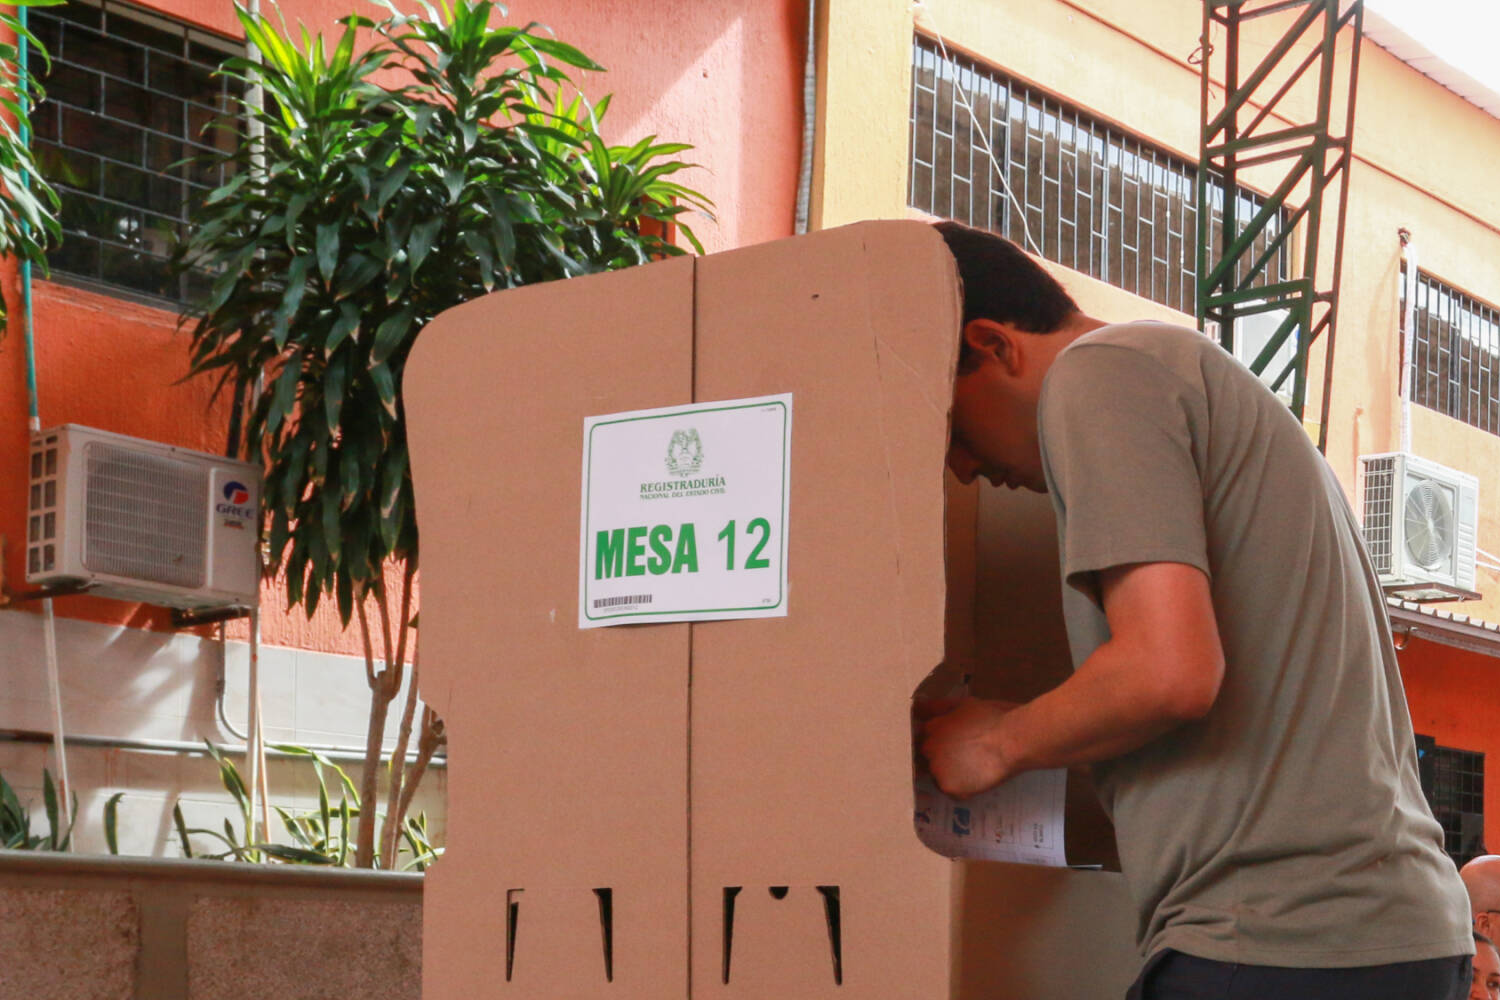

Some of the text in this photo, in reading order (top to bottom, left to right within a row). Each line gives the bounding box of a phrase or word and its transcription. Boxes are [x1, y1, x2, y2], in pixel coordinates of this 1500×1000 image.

[640, 475, 726, 493] REGISTRADURÍA
[595, 517, 771, 580] MESA 12
